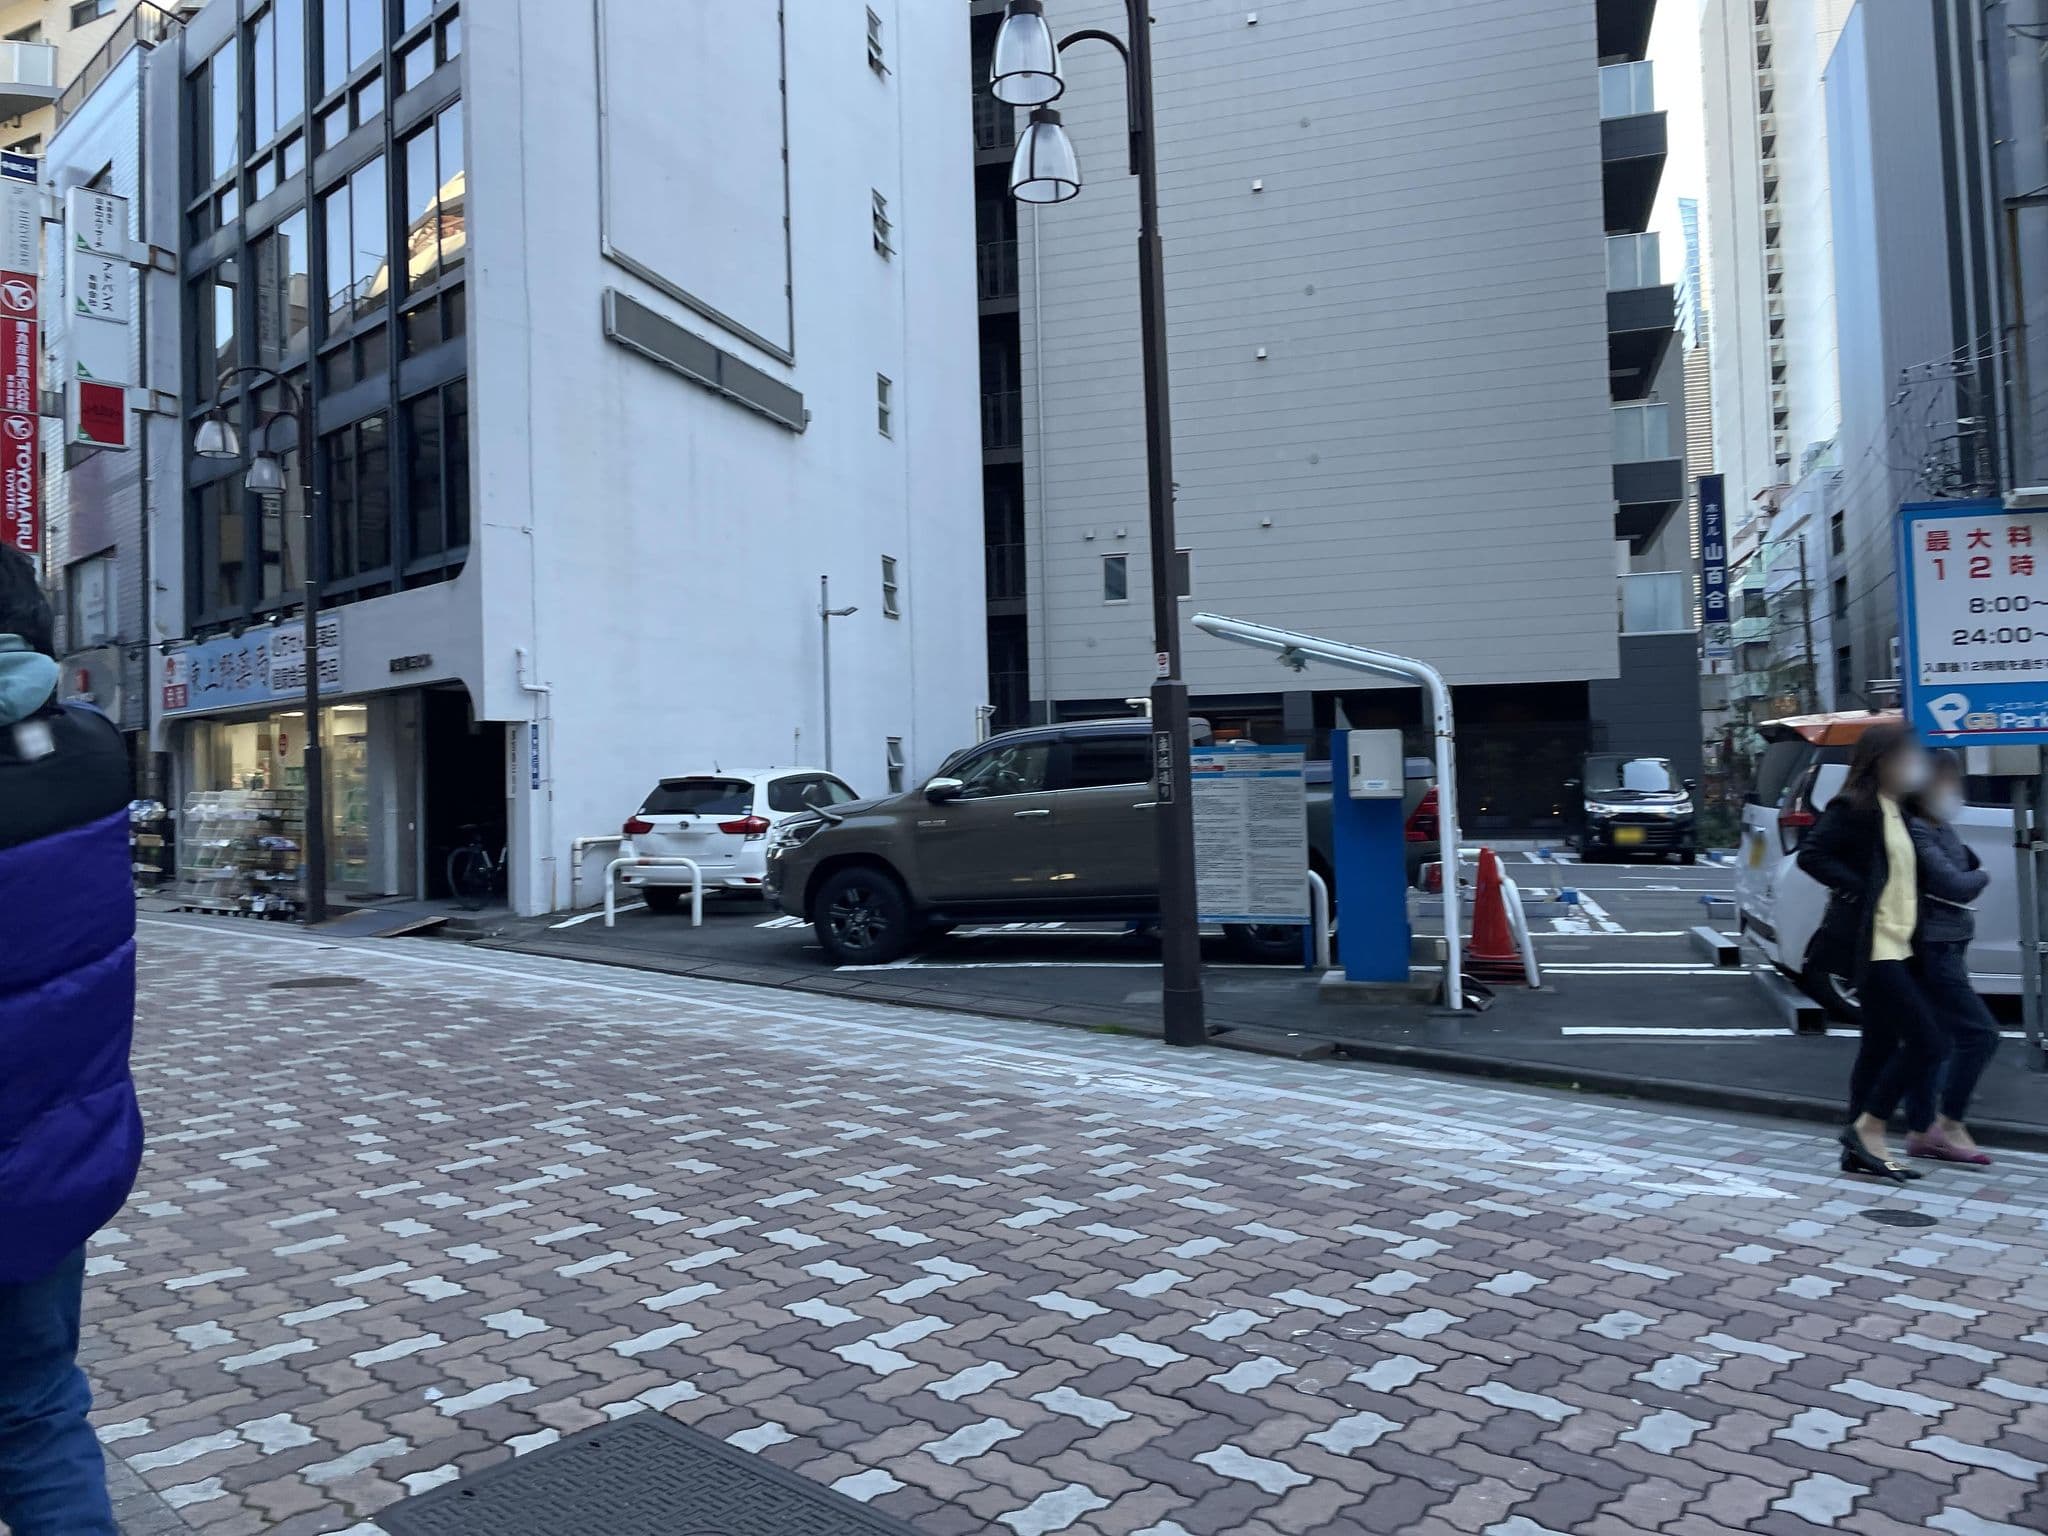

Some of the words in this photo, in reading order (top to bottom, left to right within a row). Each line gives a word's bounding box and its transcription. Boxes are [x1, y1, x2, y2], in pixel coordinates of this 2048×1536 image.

[16, 442, 32, 550] TOYOMARU
[1705, 503, 1720, 536] ホテル
[1705, 542, 1726, 609] 山百合
